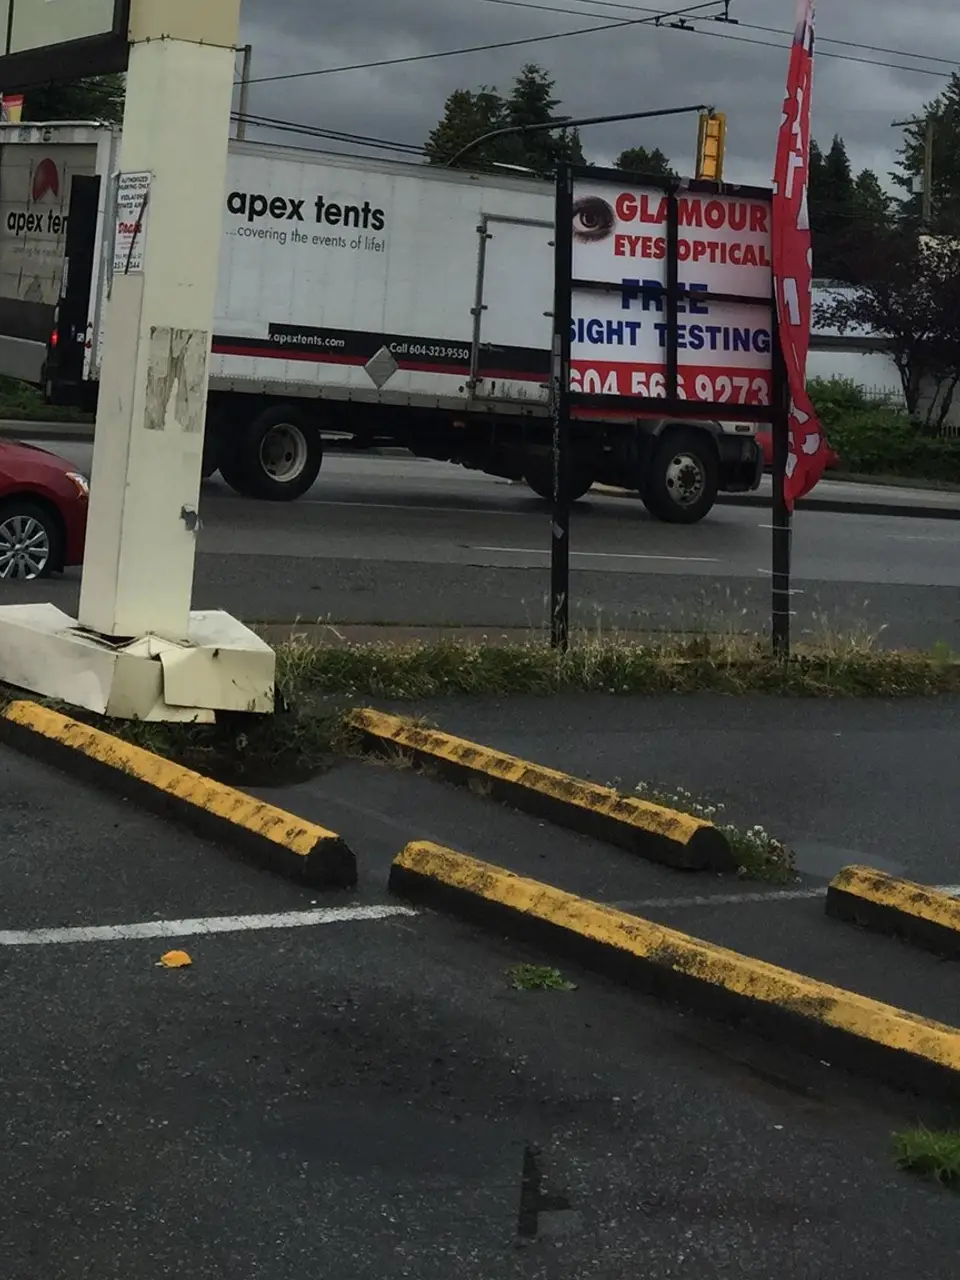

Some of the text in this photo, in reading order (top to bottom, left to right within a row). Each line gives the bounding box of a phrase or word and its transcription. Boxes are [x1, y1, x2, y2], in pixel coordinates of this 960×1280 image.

[7, 212, 43, 236] apex
[227, 191, 385, 231] apex tents
[615, 192, 768, 233] GLAMOUR
[291, 228, 308, 244] the
[312, 234, 347, 248] events
[350, 235, 362, 251] of
[614, 234, 771, 268] EYES OPTICAL
[389, 342, 469, 360] Call 604-323-9550
[569, 318, 771, 353] SIGHT TESTING
[569, 368, 621, 396] 604
[694, 373, 770, 407] 9273
